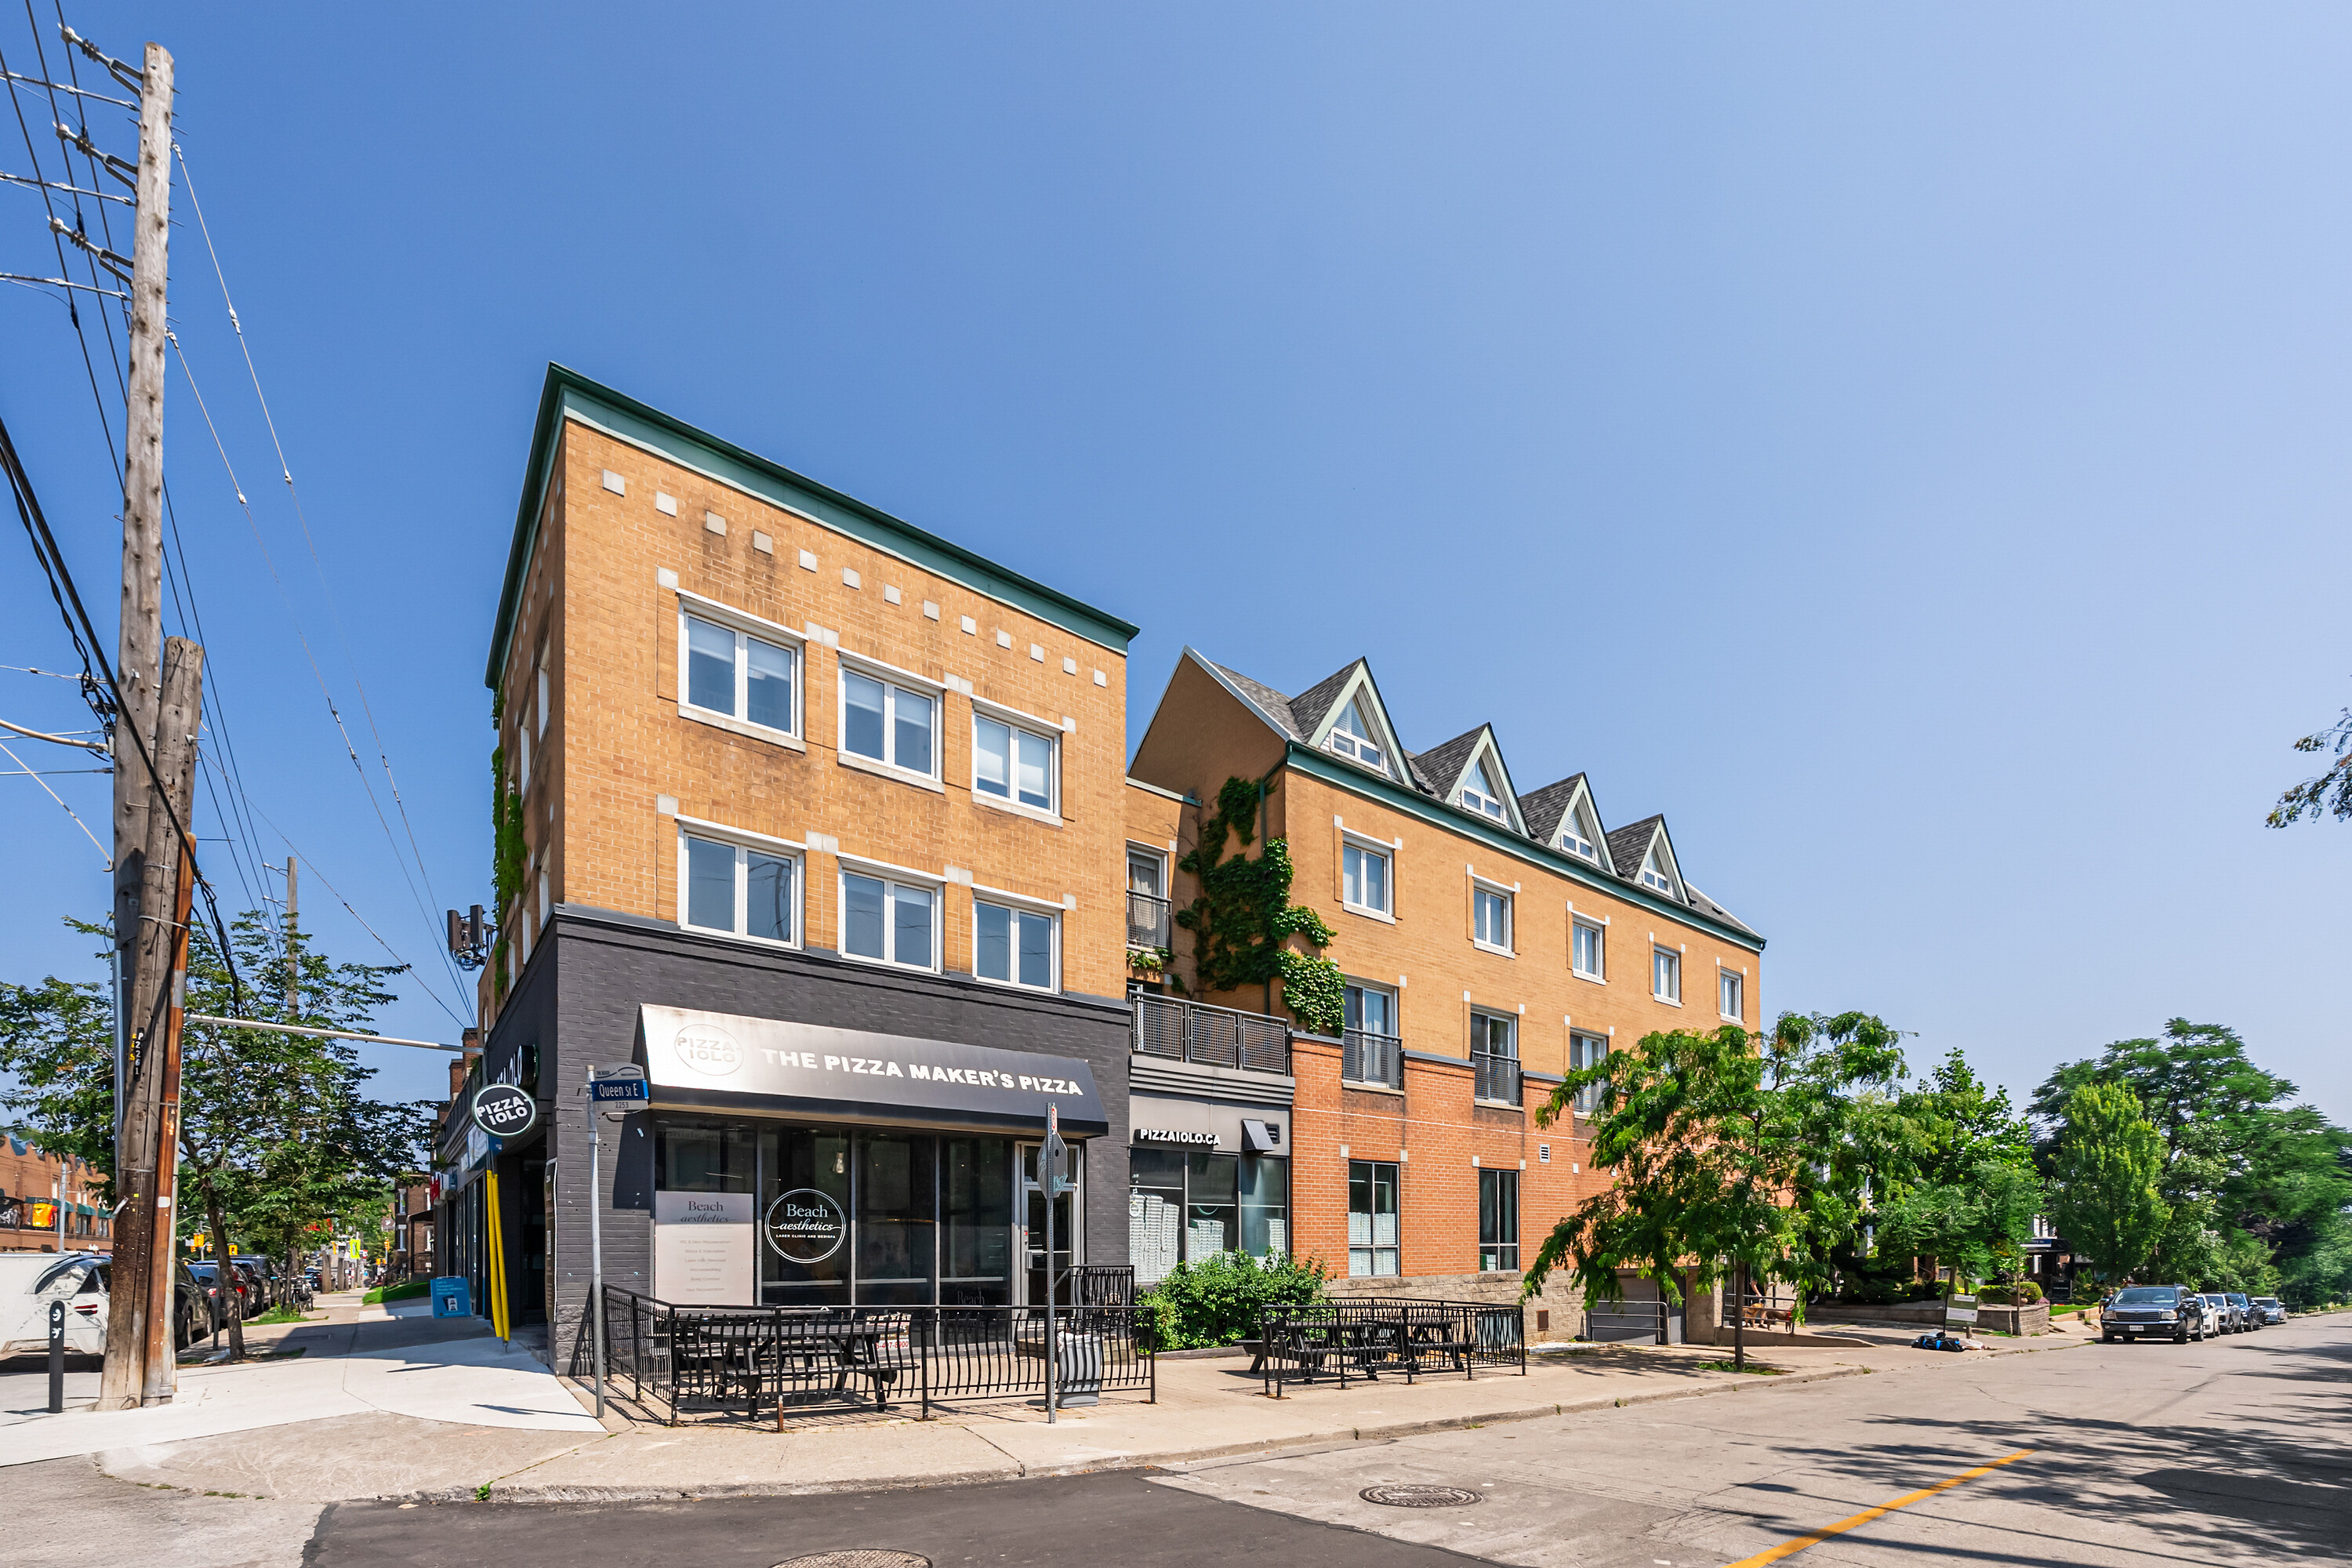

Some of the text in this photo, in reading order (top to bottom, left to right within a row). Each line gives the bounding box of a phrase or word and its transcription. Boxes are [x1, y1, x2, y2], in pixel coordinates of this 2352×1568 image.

[690, 1048, 735, 1063] IOLO
[759, 1048, 1083, 1096] THE PIZZA MAKER'S PIZZA
[599, 1083, 639, 1098] Queen St E
[488, 1106, 528, 1126] IOLO
[1140, 1128, 1221, 1145] PIZZAIOLO.CA
[688, 1200, 724, 1211] Beach
[786, 1203, 828, 1218] Beach
[676, 1212, 732, 1223] aesthetics
[775, 1218, 837, 1231] aesthetics
